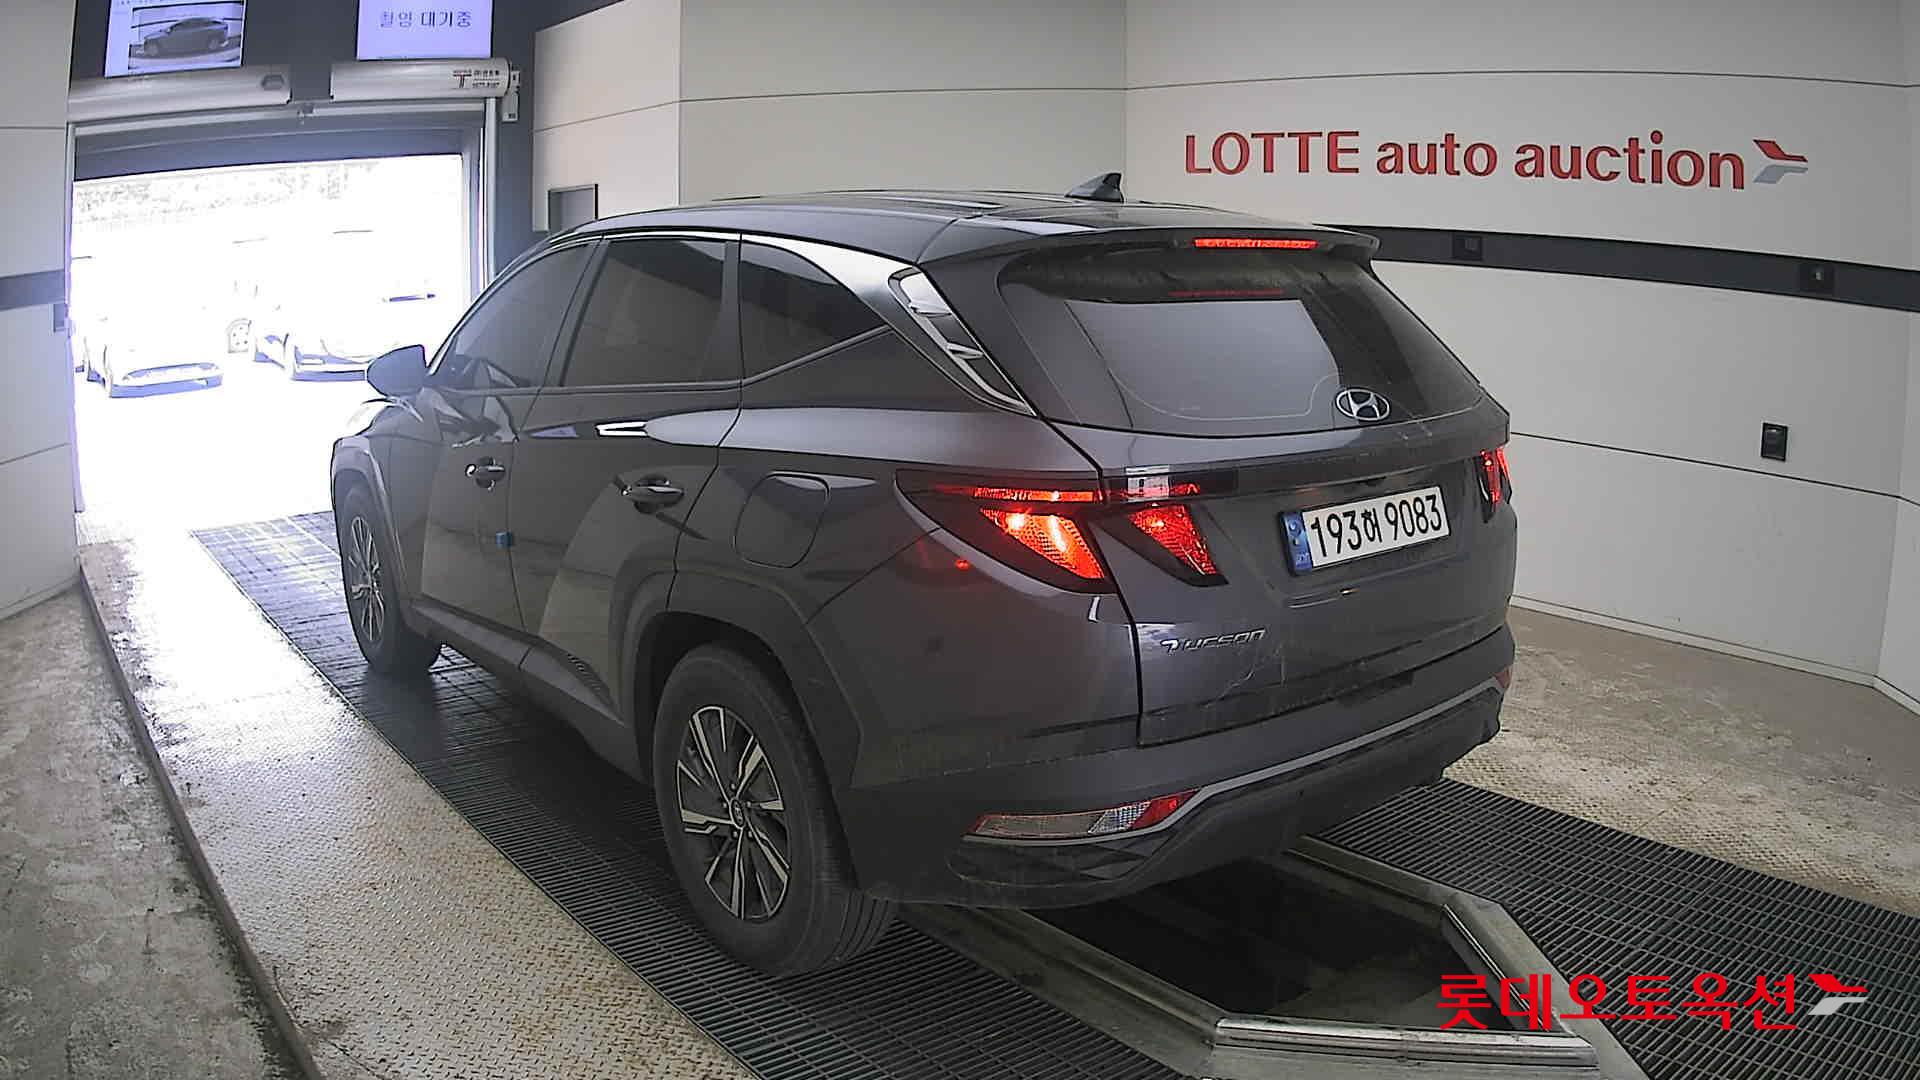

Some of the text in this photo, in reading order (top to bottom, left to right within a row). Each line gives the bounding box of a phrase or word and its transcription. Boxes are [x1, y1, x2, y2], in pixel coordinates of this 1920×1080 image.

[1184, 130, 1746, 189] LOTTE auto auction
[1310, 494, 1442, 558] 193허 9083
